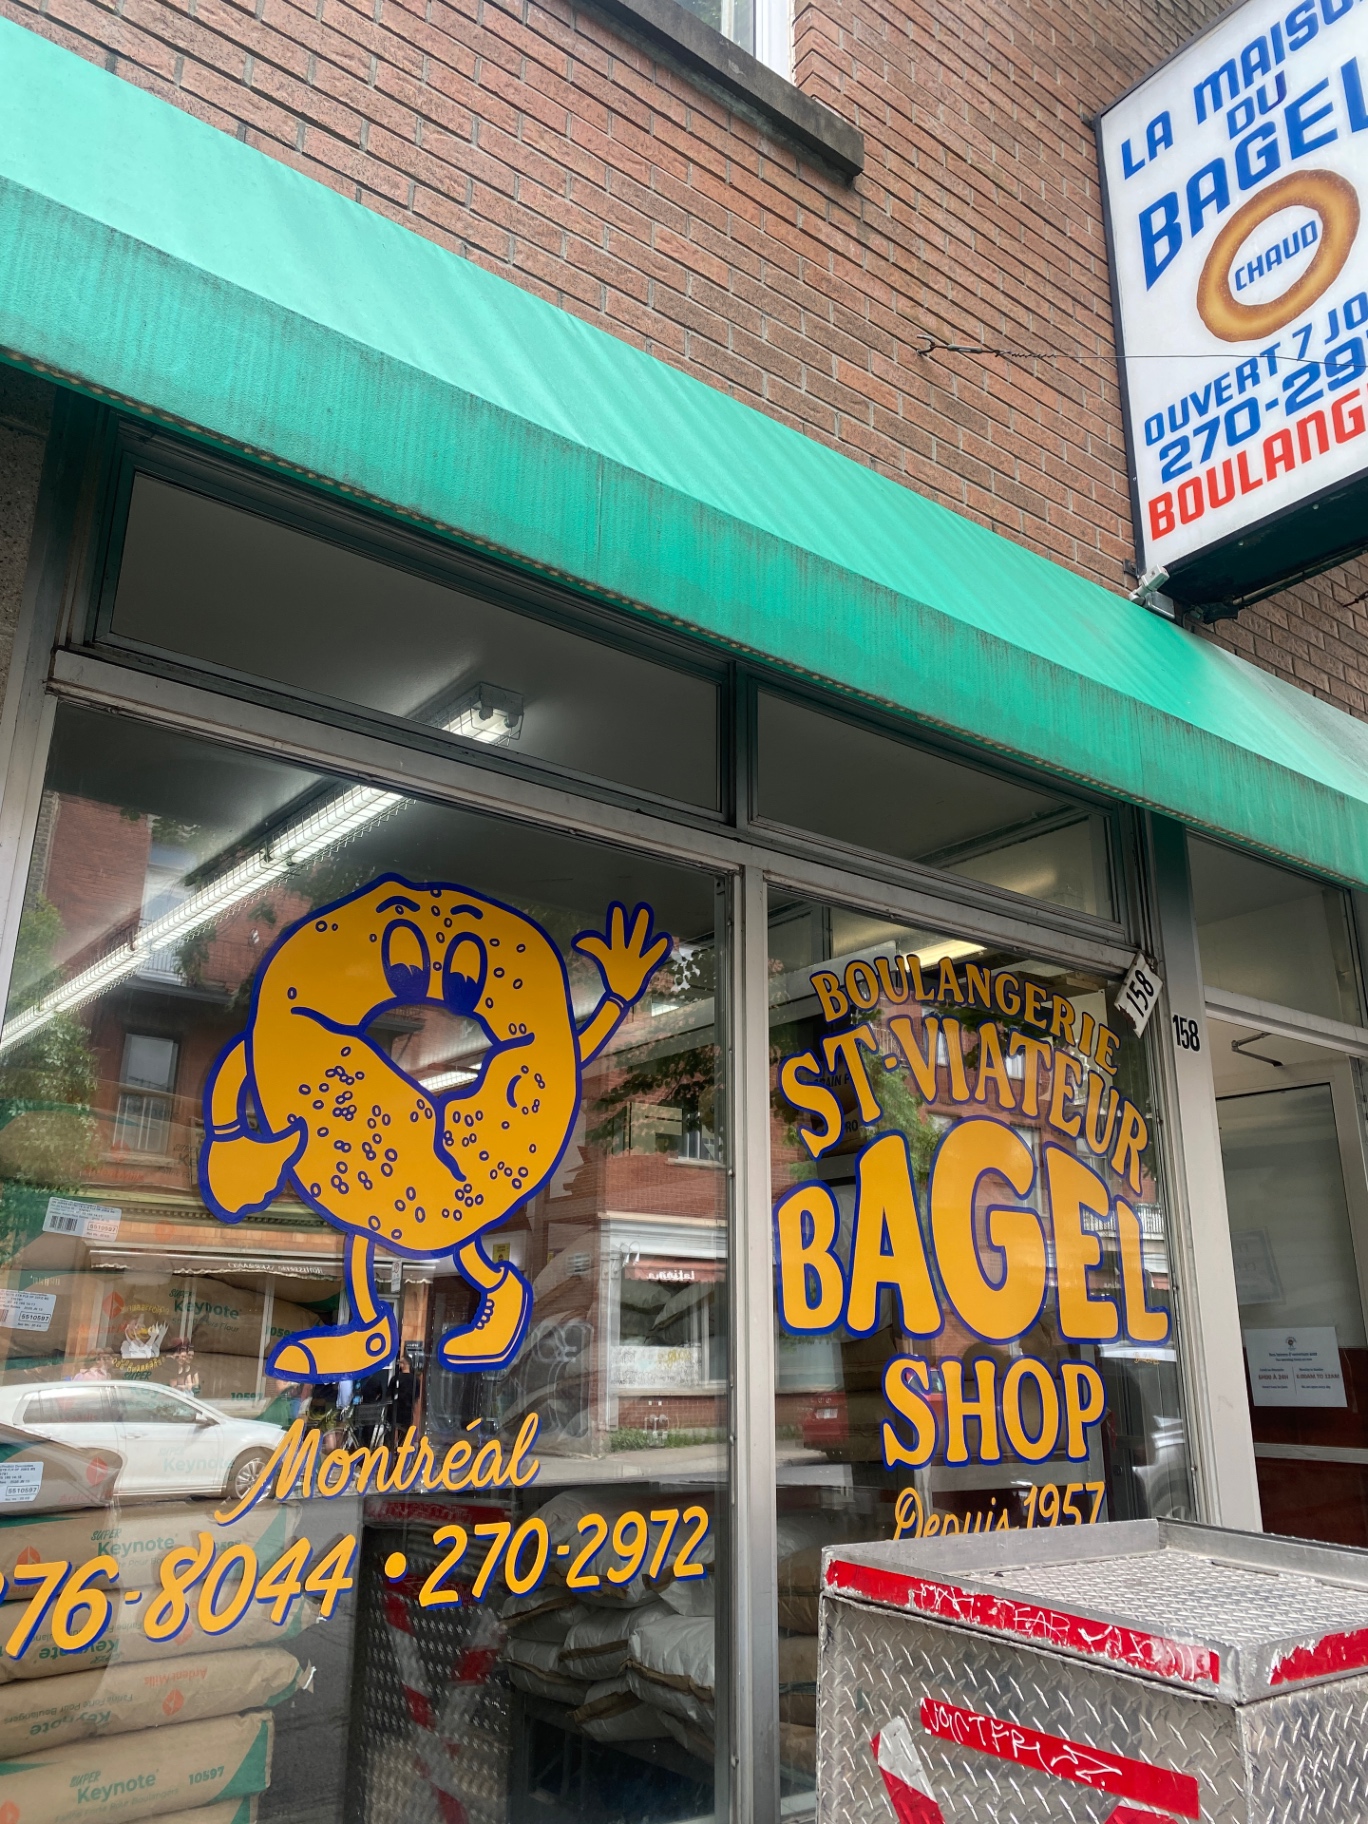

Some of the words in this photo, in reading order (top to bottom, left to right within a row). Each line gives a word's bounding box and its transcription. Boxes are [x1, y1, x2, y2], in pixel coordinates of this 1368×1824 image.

[1226, 70, 1287, 140] DU
[1121, 110, 1173, 181] LA
[1139, 56, 1368, 292] BAGEL
[1234, 220, 1318, 291] CHAUD
[1144, 342, 1281, 447] OUVERT
[1292, 323, 1313, 361] 7
[1324, 291, 1368, 345] JO
[1159, 329, 1368, 484] 270-29
[1148, 383, 1368, 541] BOULANG
[810, 954, 1121, 1076] BOULANGERIE
[1126, 970, 1154, 1018] 158
[1173, 1014, 1200, 1052] 158
[774, 1115, 1171, 1346] BAGEL
[880, 1353, 1107, 1472] SHOP
[215, 1412, 541, 1526] Montréal
[91, 1528, 122, 1541] SUPER
[1023, 1481, 1107, 1530] 1957
[97, 1537, 175, 1558] Keynote
[419, 1506, 709, 1610] 270-2972
[69, 1769, 102, 1788] SUPER
[77, 1773, 157, 1804] Keynote
[188, 1765, 225, 1786] 10597
